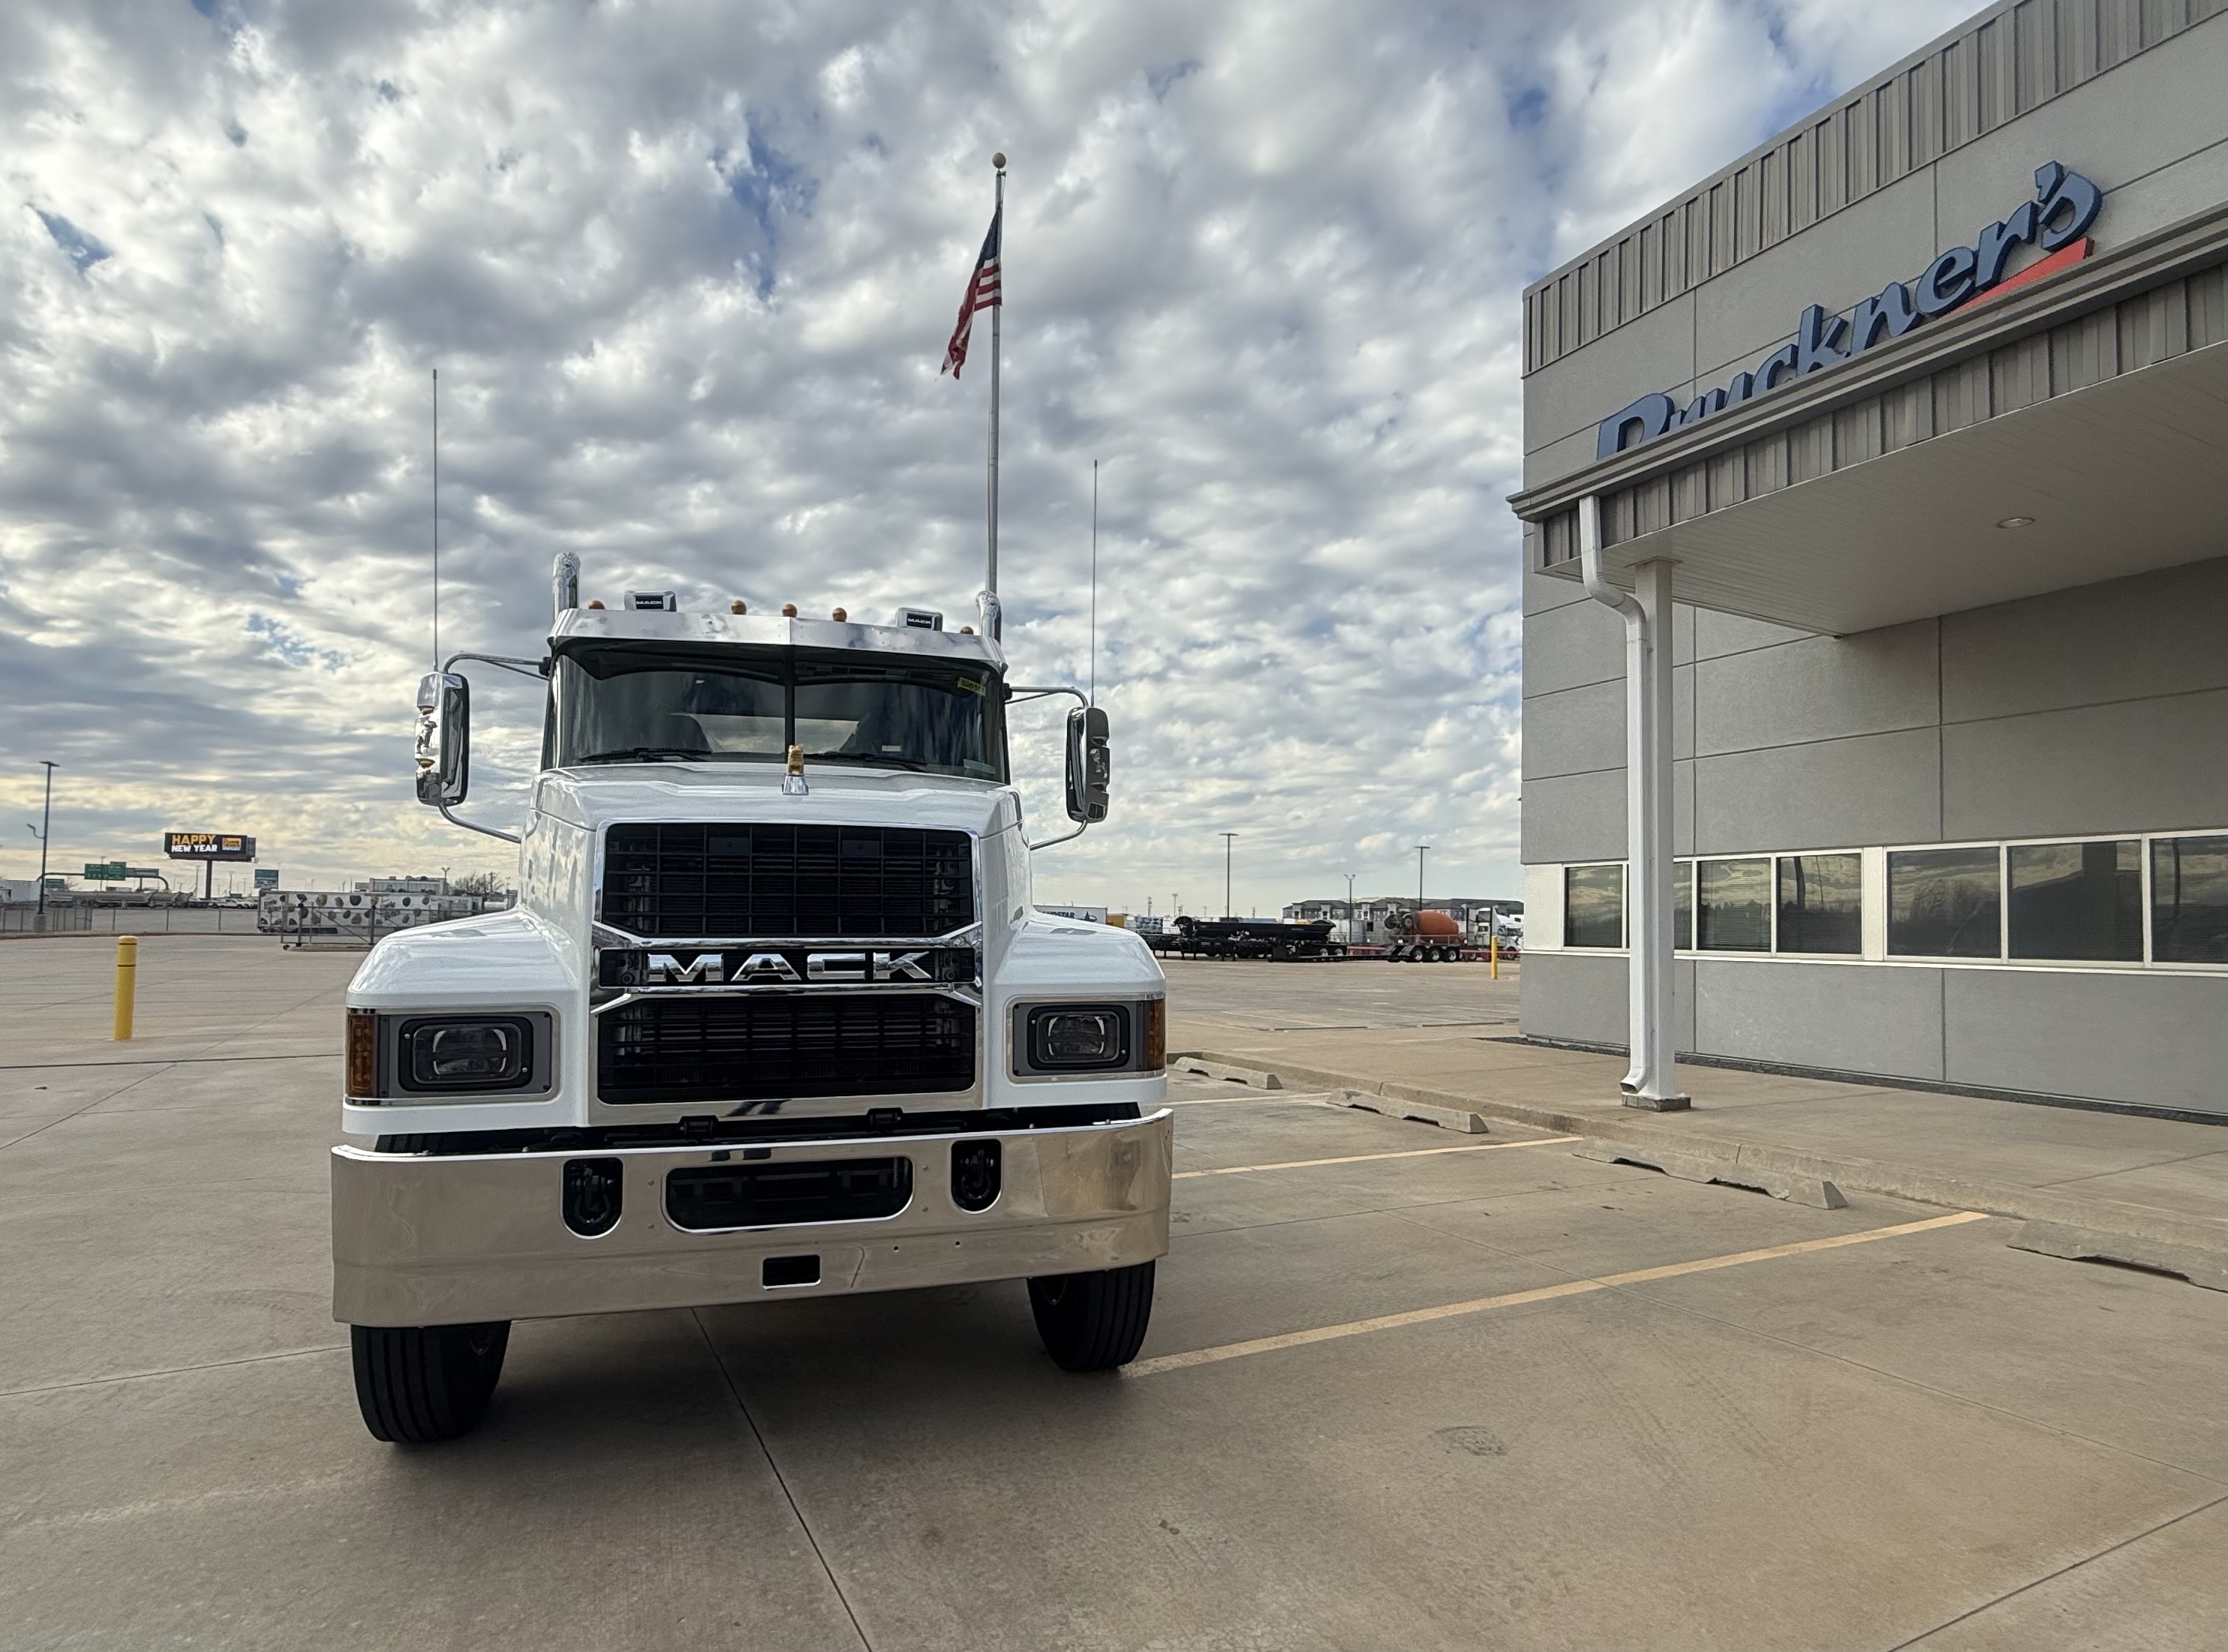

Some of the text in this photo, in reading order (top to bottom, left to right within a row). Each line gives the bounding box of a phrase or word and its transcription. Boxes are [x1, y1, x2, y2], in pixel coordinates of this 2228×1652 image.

[172, 834, 216, 845] HAPPY
[194, 844, 218, 852] YEAR
[648, 951, 933, 982] MACK
